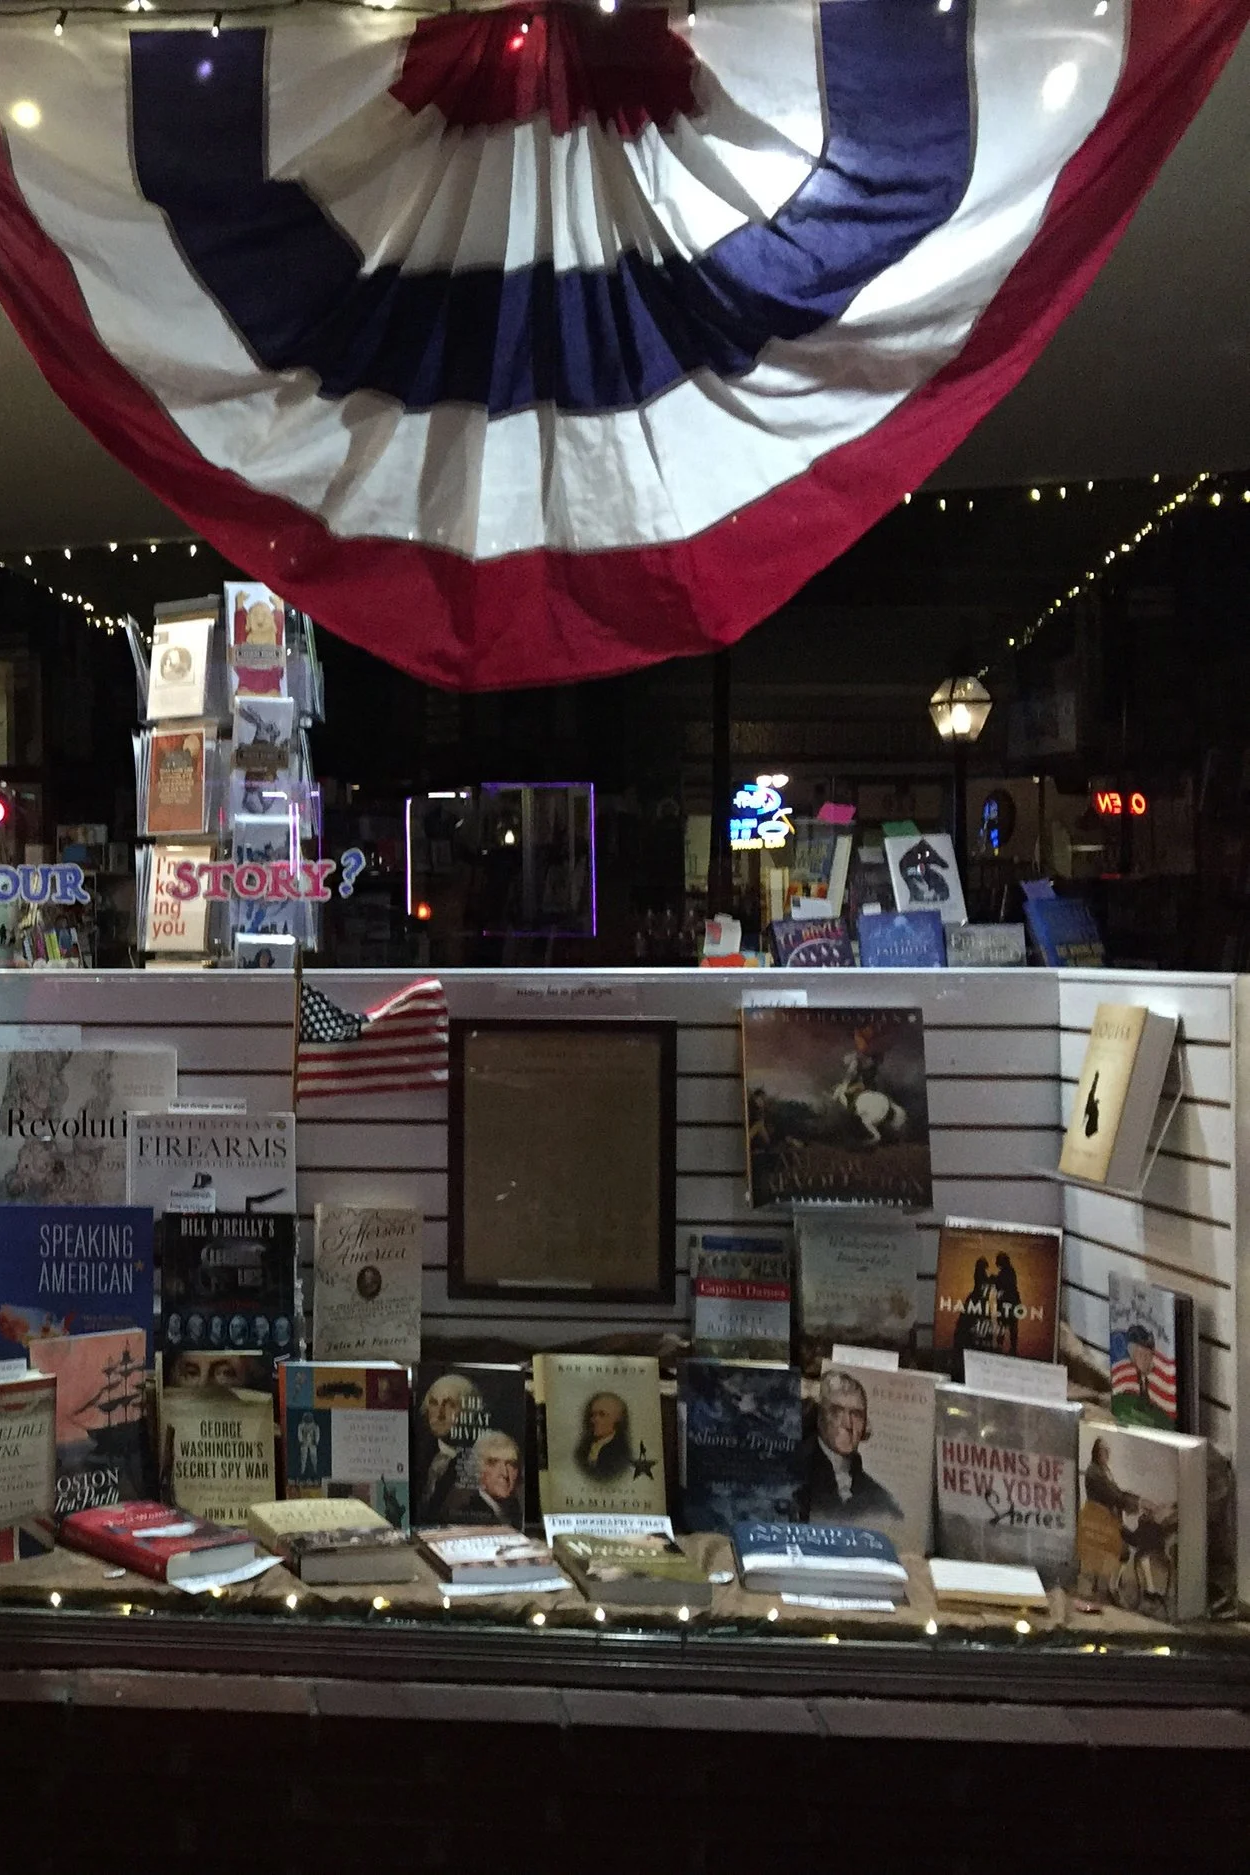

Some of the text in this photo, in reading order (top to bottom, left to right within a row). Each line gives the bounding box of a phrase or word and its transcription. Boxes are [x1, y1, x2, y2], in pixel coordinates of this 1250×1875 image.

[152, 920, 186, 938] you
[137, 1134, 288, 1159] FIREARMS
[180, 1217, 276, 1238] BILL O'REILLY'S
[39, 1223, 134, 1259] SPEAKING
[38, 1260, 134, 1295] AMERICAN
[940, 1295, 1045, 1321] HAMILTON
[461, 1395, 486, 1412] THE
[199, 1419, 243, 1440] GEORGE
[452, 1411, 492, 1427] GREAT
[179, 1440, 264, 1460] WASHINGTON'S
[176, 1460, 270, 1481] SECRET SPY WAR
[942, 1440, 1065, 1482] HUMANS OF
[53, 1466, 120, 1494] OSTON
[943, 1467, 1065, 1513] NEW YORK
[565, 1496, 653, 1509] HAMILTON
[986, 1488, 1067, 1531] Stories
[203, 1507, 225, 1520] JOHN
